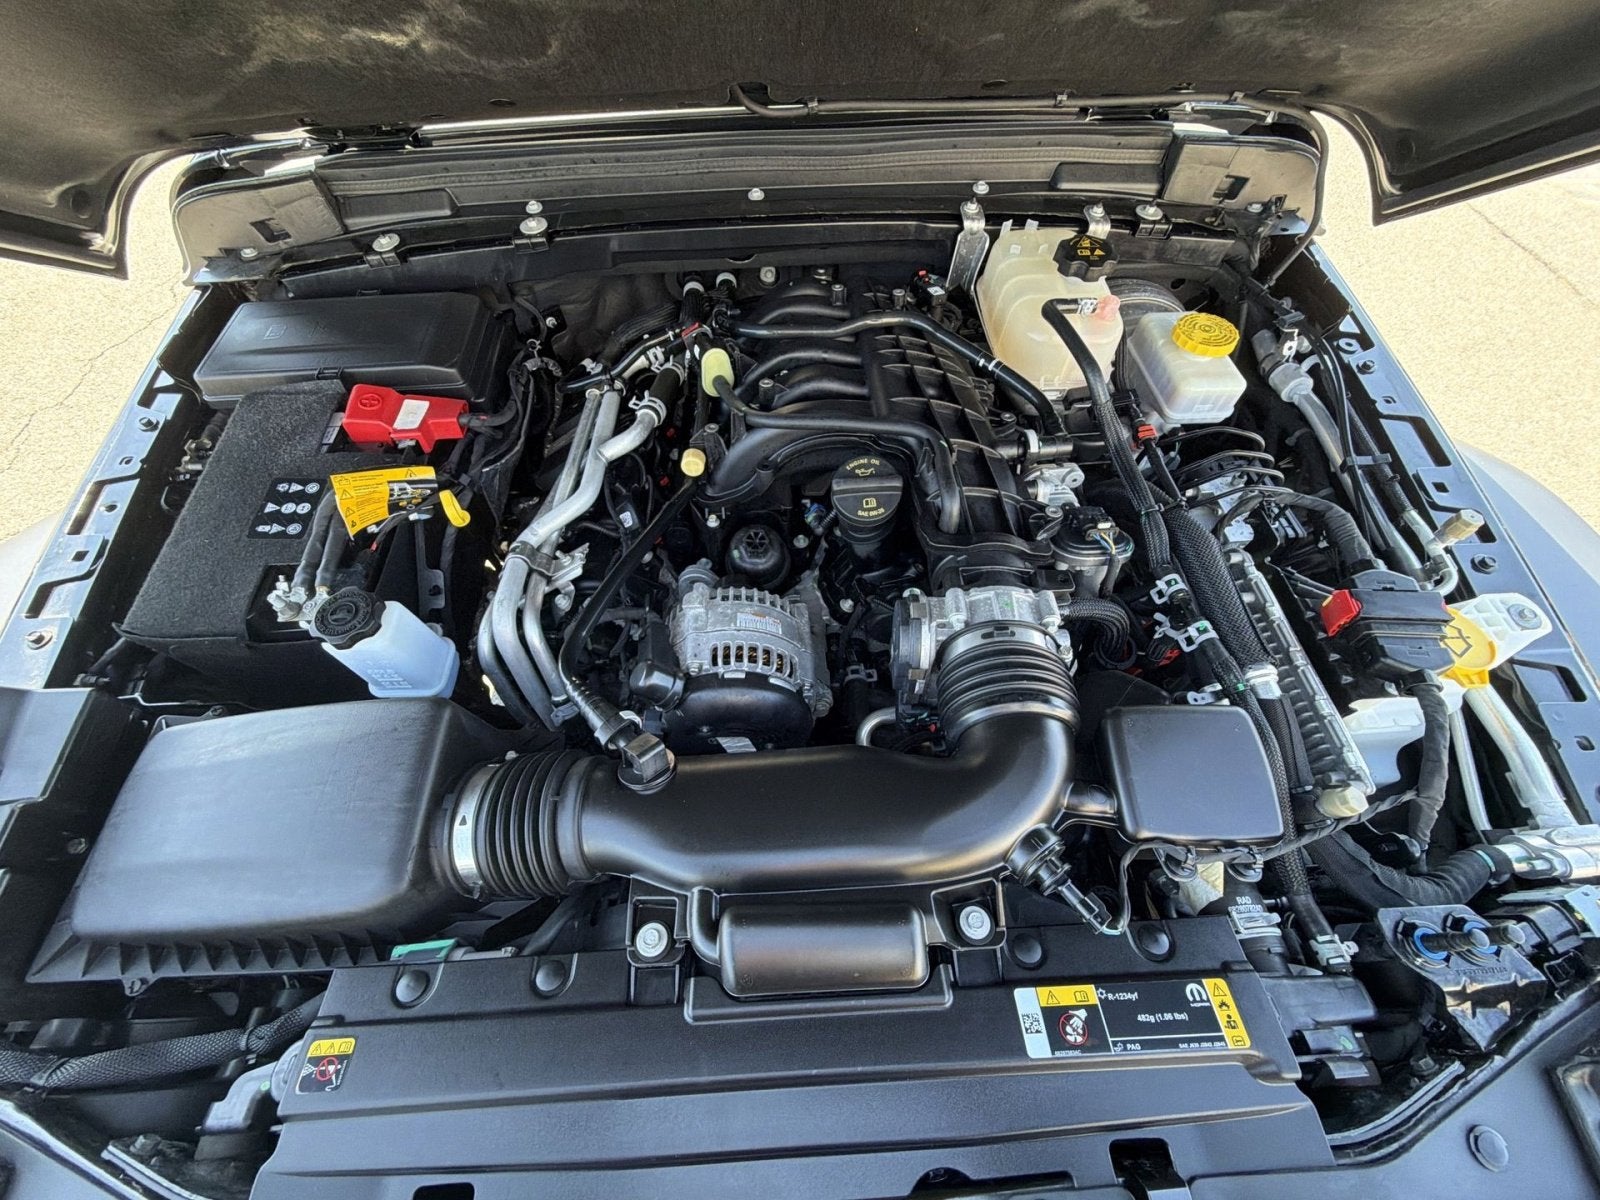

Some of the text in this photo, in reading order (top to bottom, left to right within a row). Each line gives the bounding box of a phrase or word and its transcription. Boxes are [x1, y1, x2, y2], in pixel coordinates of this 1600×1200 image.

[846, 458, 868, 470] ENGINE
[1236, 896, 1251, 904] RAD
[1107, 991, 1139, 1001] R-1234yf
[1137, 1014, 1155, 1023] 482g
